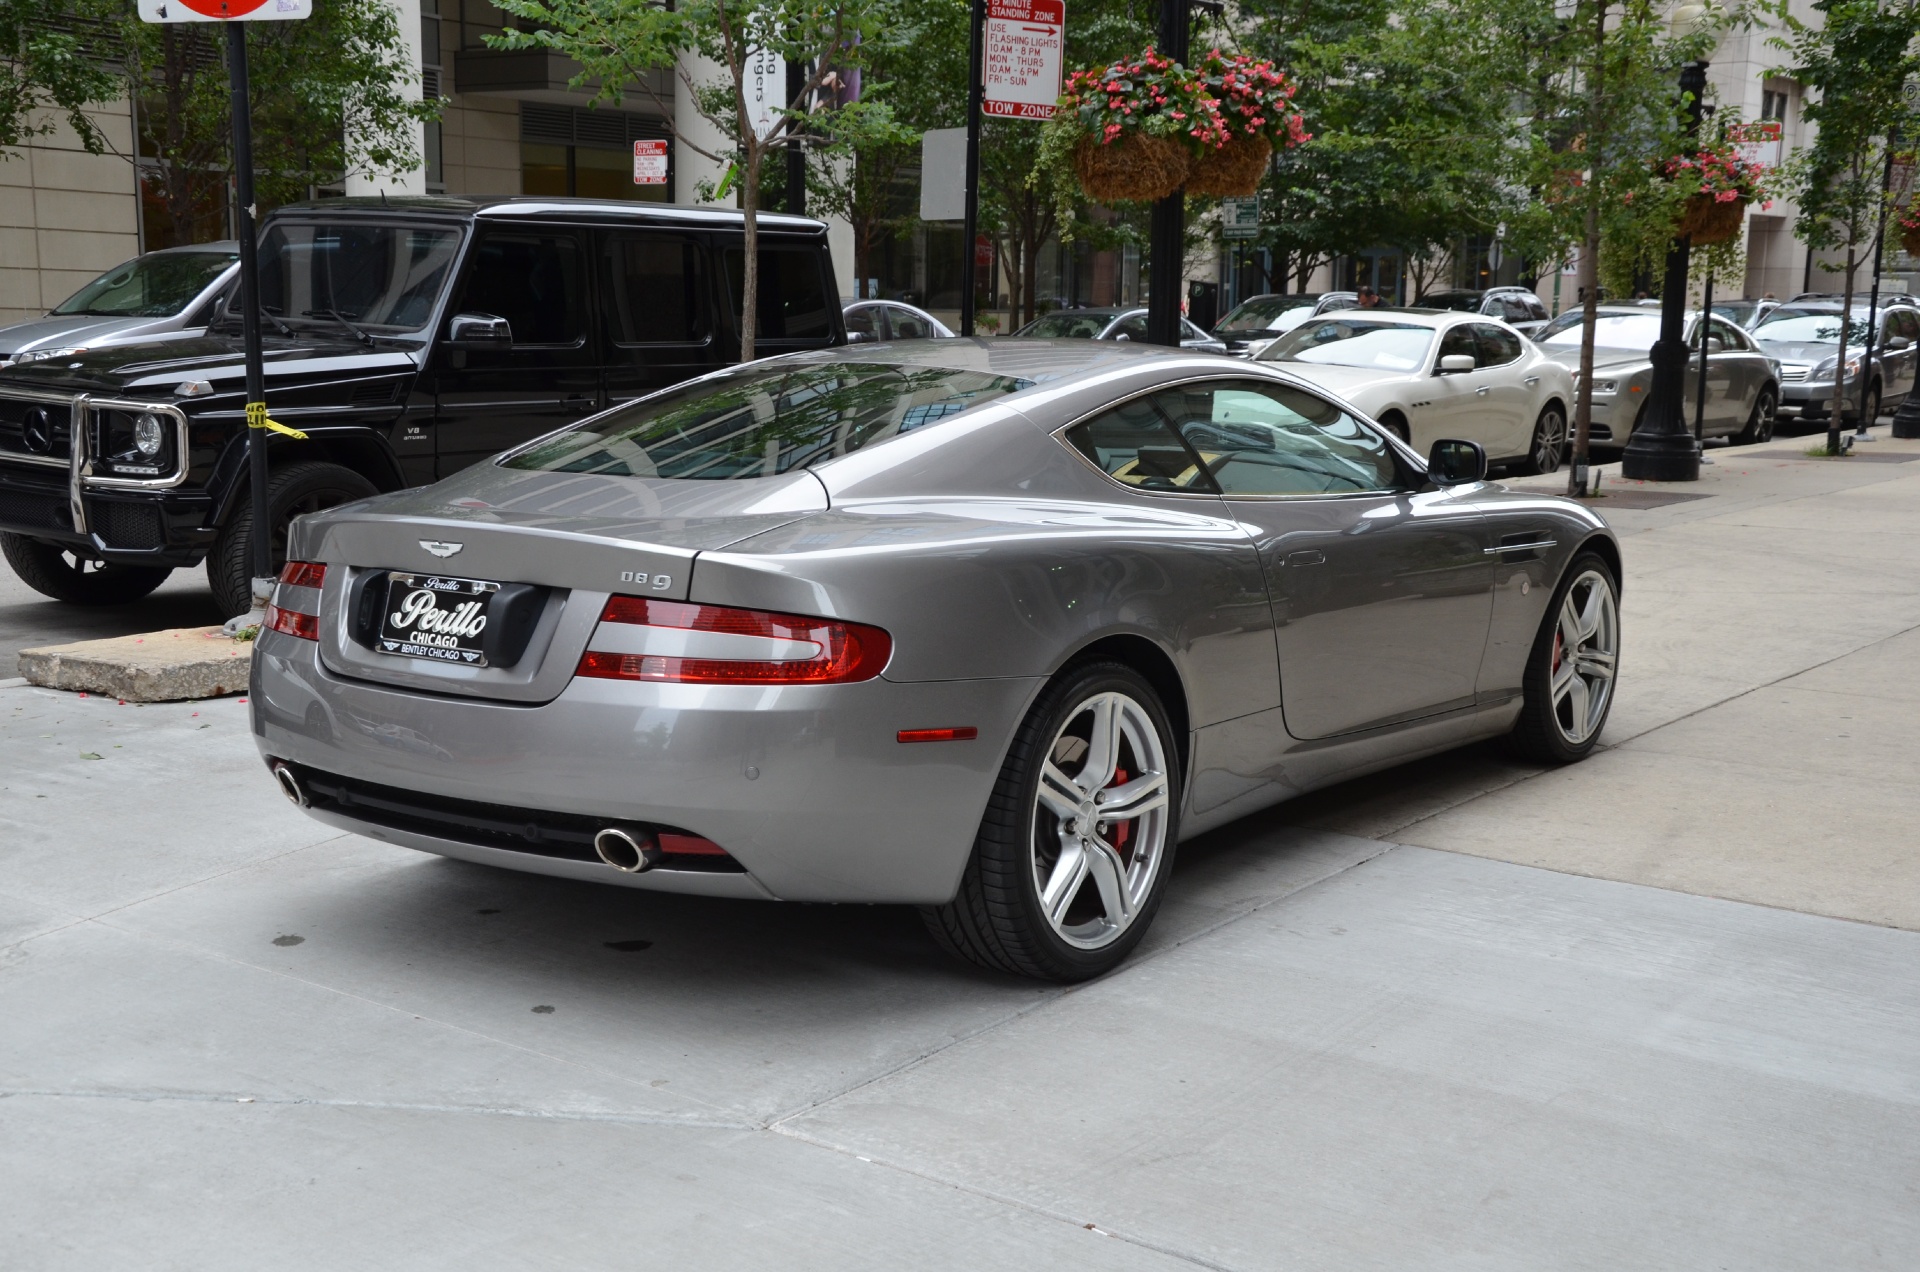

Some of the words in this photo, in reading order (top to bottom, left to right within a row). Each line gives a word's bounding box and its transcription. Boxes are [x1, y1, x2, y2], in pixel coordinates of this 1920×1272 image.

[1002, 0, 1032, 9] MINUTE
[991, 6, 1030, 19] STANDING
[1034, 11, 1055, 22] ZONE
[990, 23, 1006, 33] USE
[990, 33, 1029, 46] FLASHING
[1031, 37, 1058, 49] LIGHTS
[990, 43, 999, 53] 10
[1000, 45, 1013, 54] AM
[1020, 47, 1026, 55] 8
[1029, 47, 1041, 56] PM
[989, 54, 1008, 64] MON
[1017, 56, 1044, 67] THURS
[989, 64, 998, 73] 10
[998, 65, 1011, 74] AM
[1019, 67, 1025, 76] 6
[1027, 68, 1039, 77] PM
[988, 74, 1003, 84] FRI
[1009, 76, 1027, 86] SUN
[988, 101, 1014, 114] TOW
[1020, 104, 1053, 118] ZONE
[423, 577, 460, 591] Perillo
[390, 589, 487, 638] Perillo
[409, 631, 458, 649] CHICAGO
[401, 643, 429, 656] BENTLEY
[428, 647, 460, 660] CHICAGO
